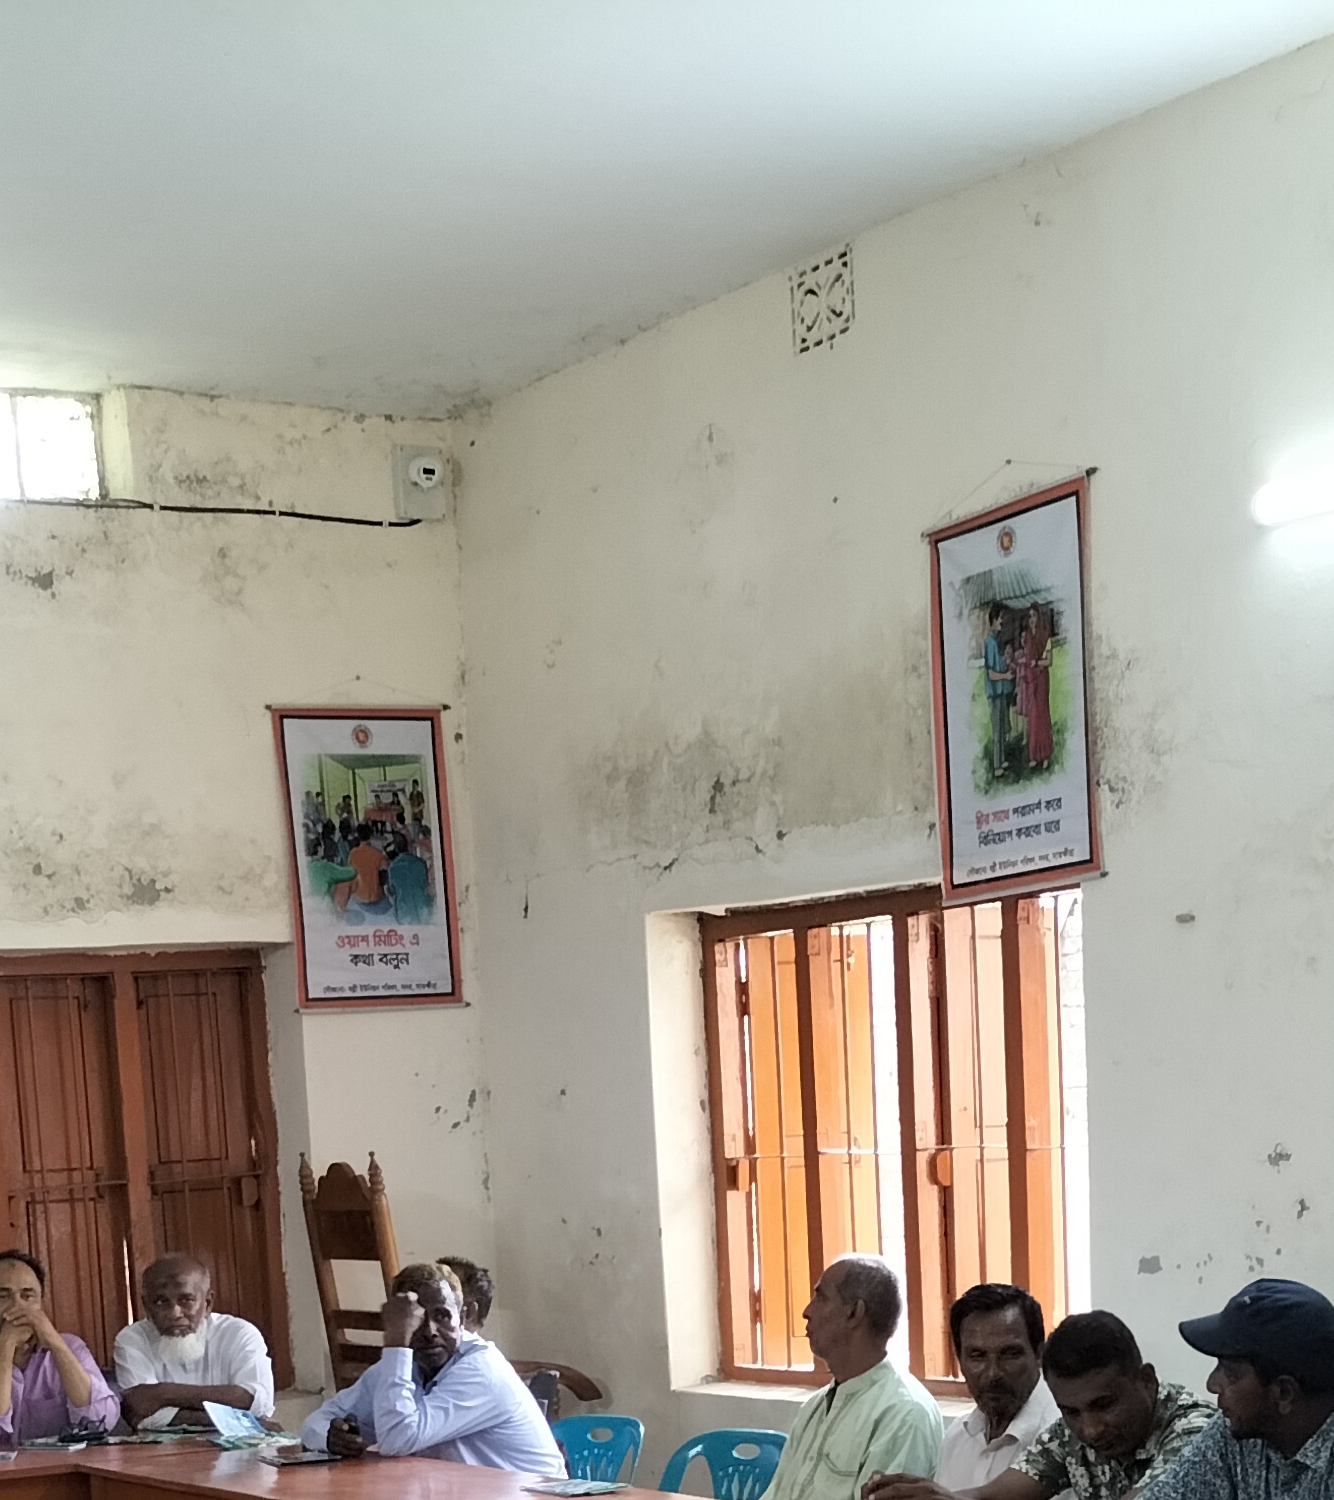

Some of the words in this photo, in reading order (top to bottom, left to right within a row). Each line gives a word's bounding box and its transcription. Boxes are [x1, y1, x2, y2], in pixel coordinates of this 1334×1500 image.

[335, 935, 369, 949] ওয়াশ
[373, 928, 405, 948] মিটিং
[410, 933, 420, 946] এ
[349, 952, 375, 967] কথা
[377, 952, 410, 970] বলুন
